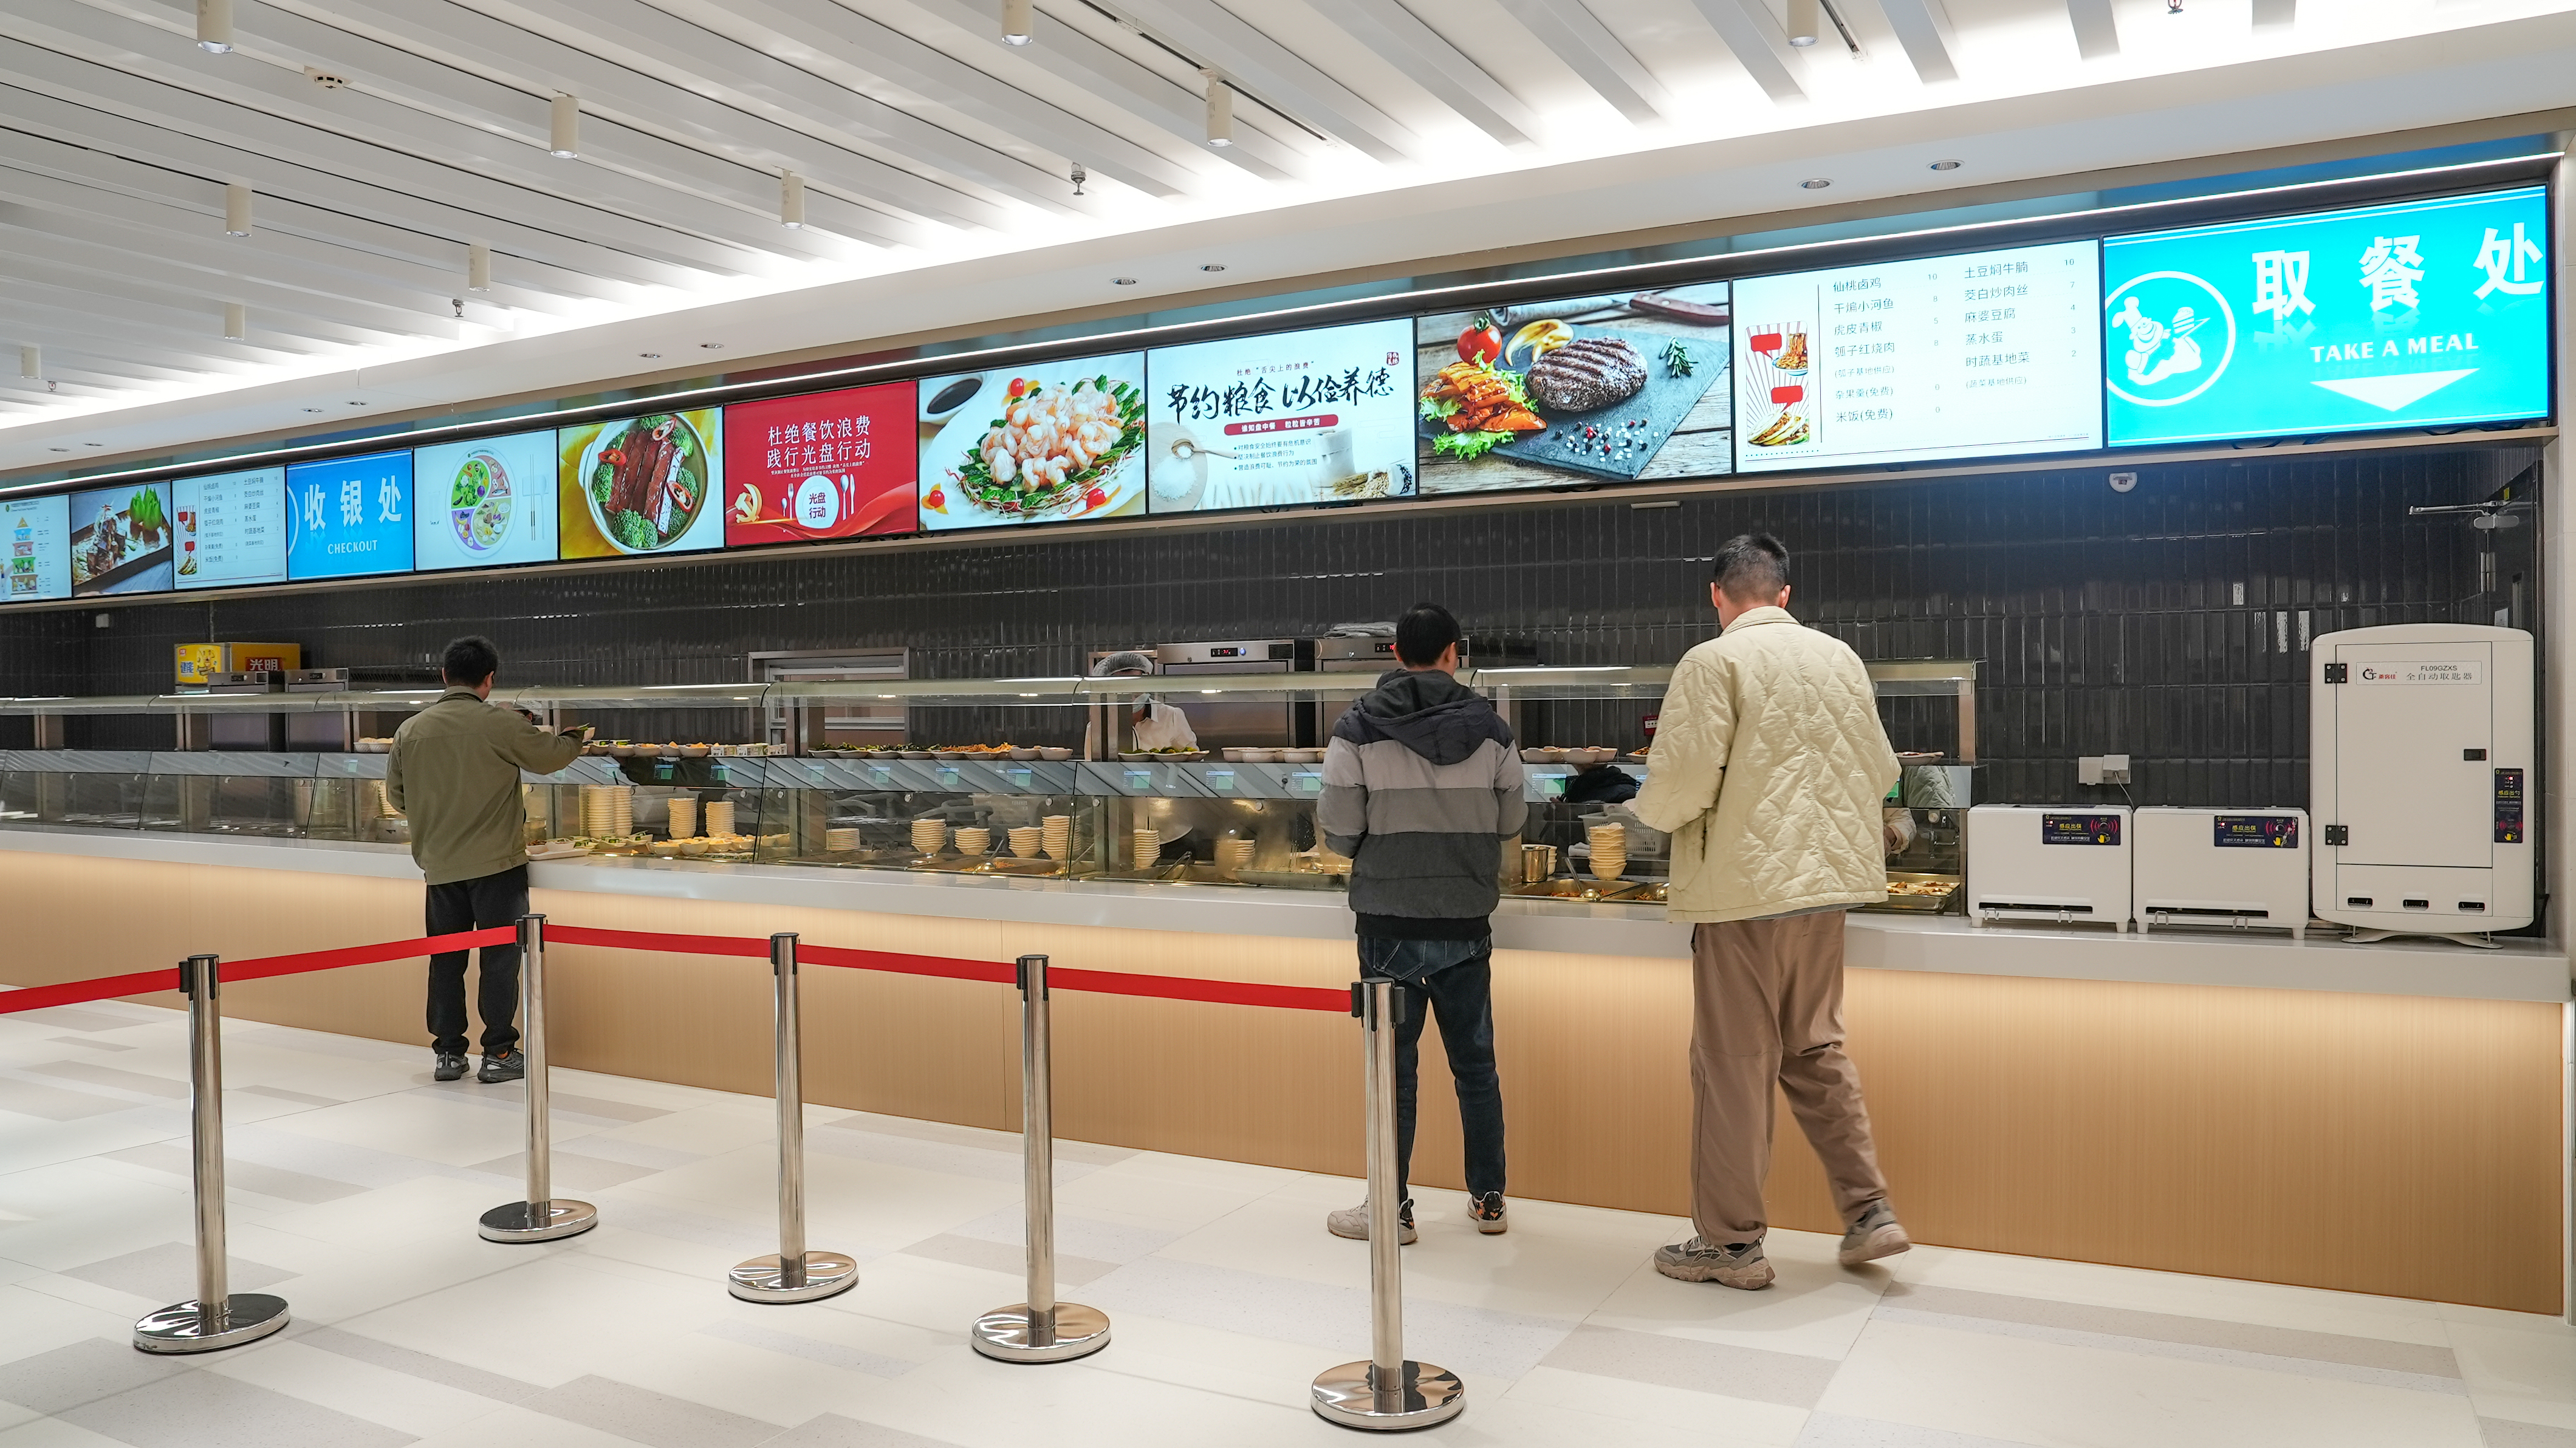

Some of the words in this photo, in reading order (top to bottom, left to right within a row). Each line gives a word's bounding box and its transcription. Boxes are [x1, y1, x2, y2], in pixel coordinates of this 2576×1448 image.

[1964, 261, 2029, 279] 土豆焖牛腩
[2252, 222, 2544, 321] 取餐处
[1833, 277, 1881, 293] 仙桃卤鸡
[1964, 284, 2029, 301] 茭白炒肉丝
[1834, 298, 1894, 314] 干煸小河鱼
[1965, 308, 2016, 323] 麻婆豆腐
[1834, 321, 1883, 336] 虎皮青椒
[1965, 331, 2003, 346] 蒸水蛋
[2311, 341, 2374, 364] TAKE
[2382, 340, 2399, 357] A
[2408, 333, 2479, 355] MEAL
[1966, 351, 2030, 367] 时蔬基地菜
[1836, 408, 1893, 422] 米饭(免费)
[767, 415, 871, 447] 杜绝餐饮浪费
[766, 439, 871, 469] 践行光盘行动
[304, 475, 402, 531] 收银处
[809, 492, 826, 505] 光盘
[809, 506, 826, 519] 行动
[327, 539, 378, 555] CHECKOUT
[250, 658, 278, 671] 光明
[2406, 672, 2473, 681] 全自动取匙器
